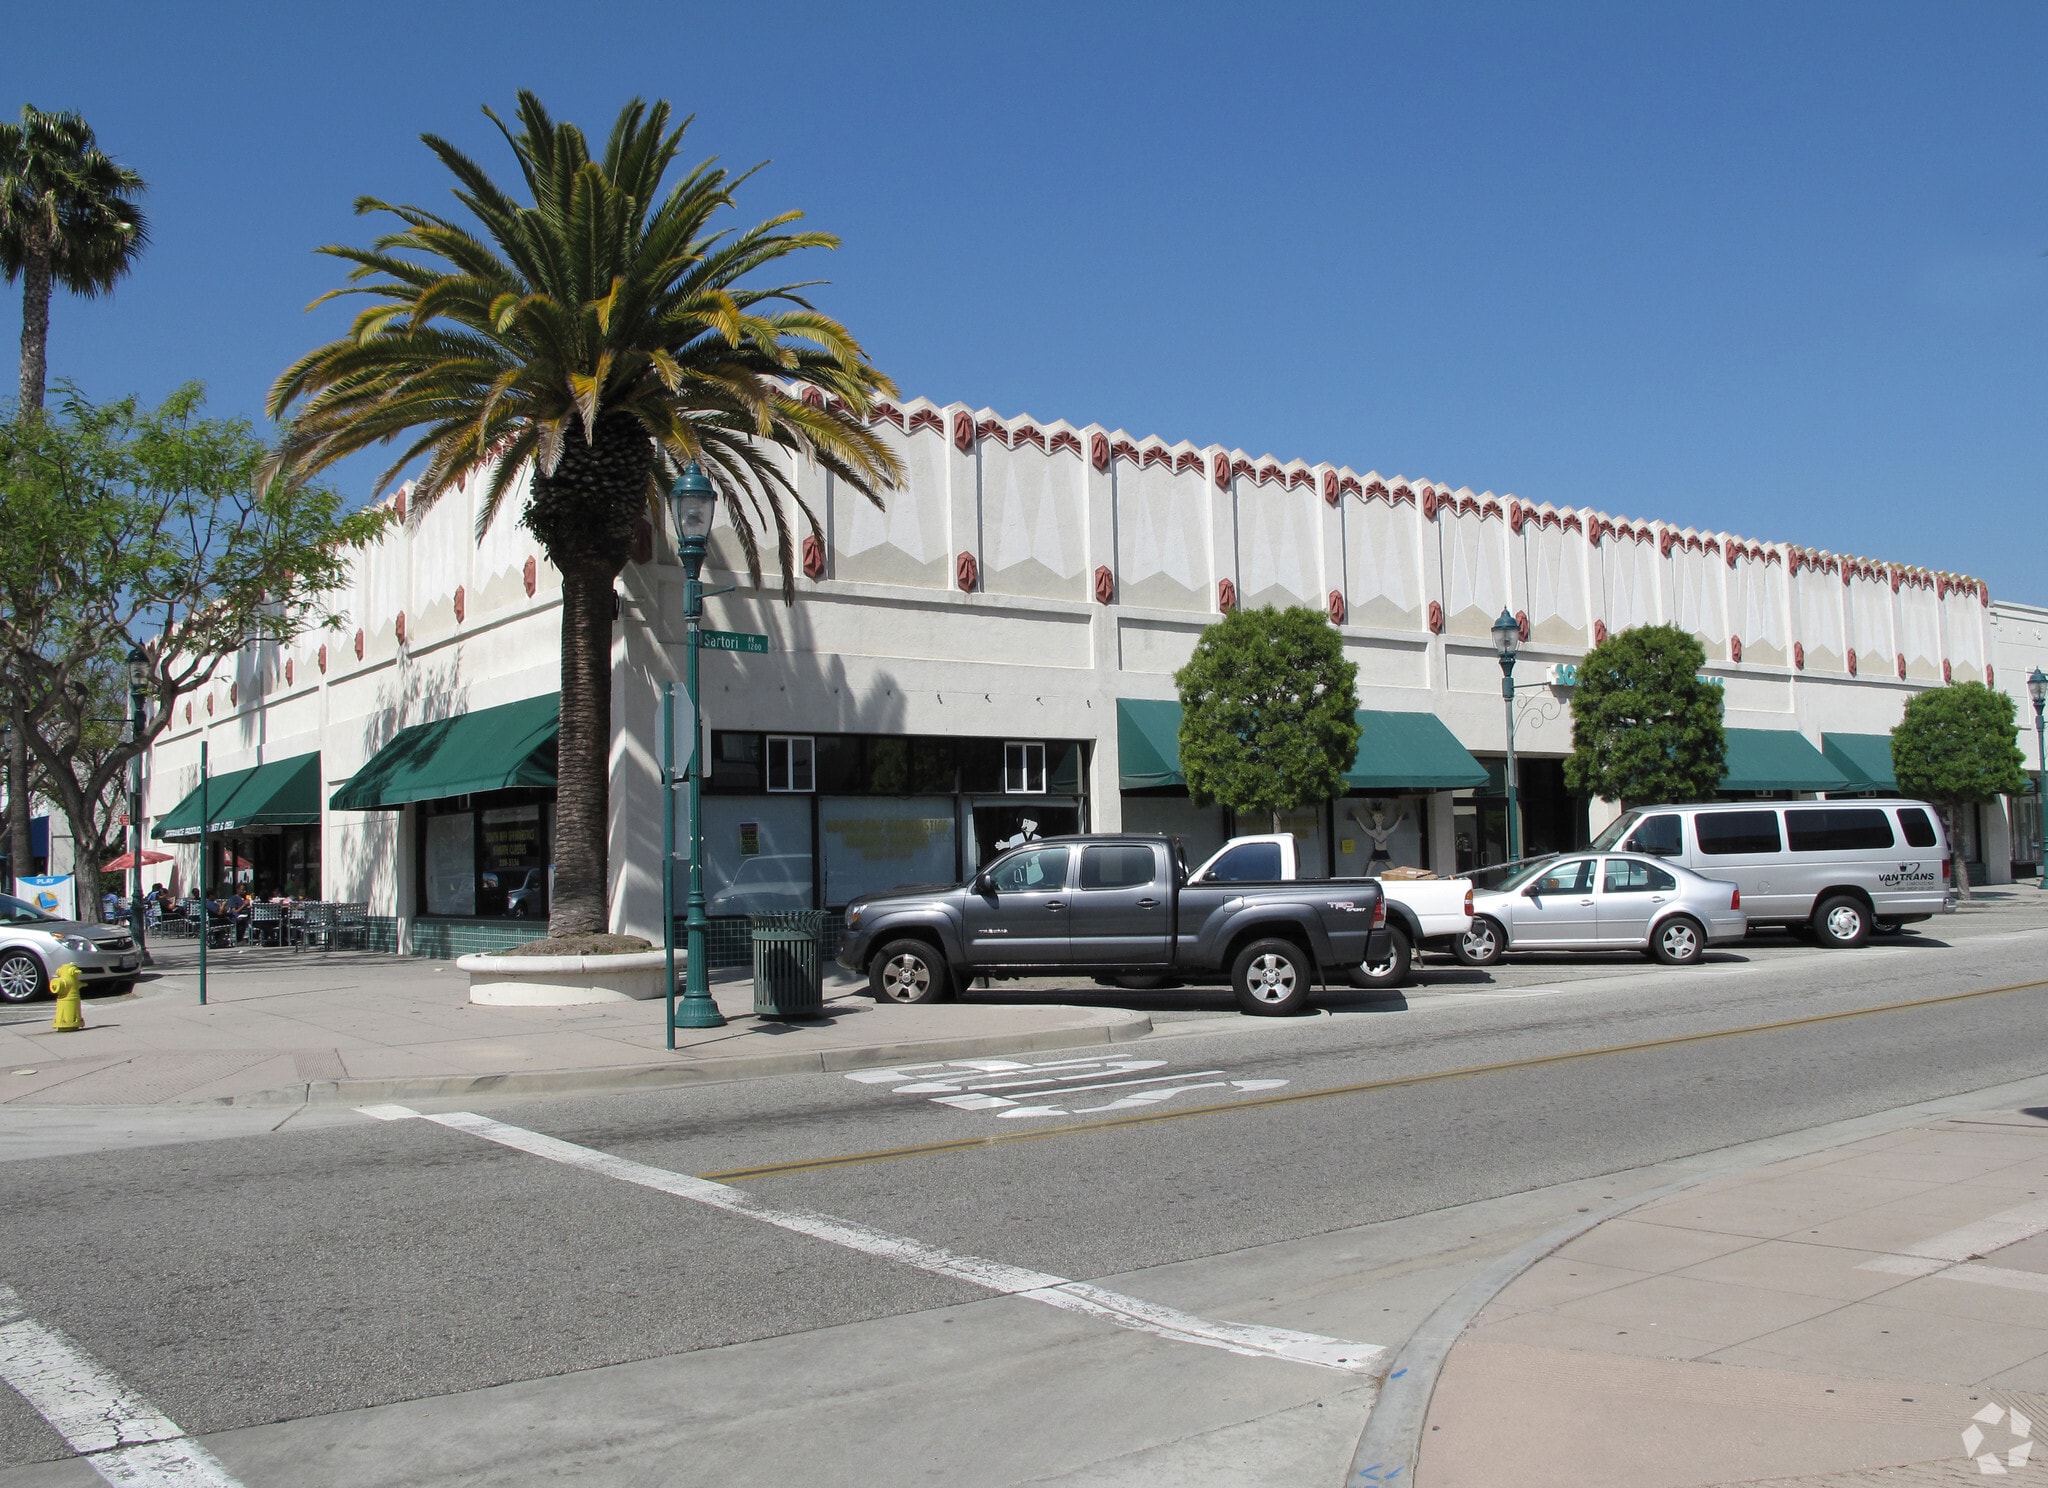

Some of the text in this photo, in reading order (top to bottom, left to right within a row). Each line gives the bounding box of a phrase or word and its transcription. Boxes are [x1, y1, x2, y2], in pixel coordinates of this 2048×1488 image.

[704, 633, 739, 649] Sartori
[1878, 873, 1935, 882] VANTRANS
[1327, 901, 1354, 910] TRD
